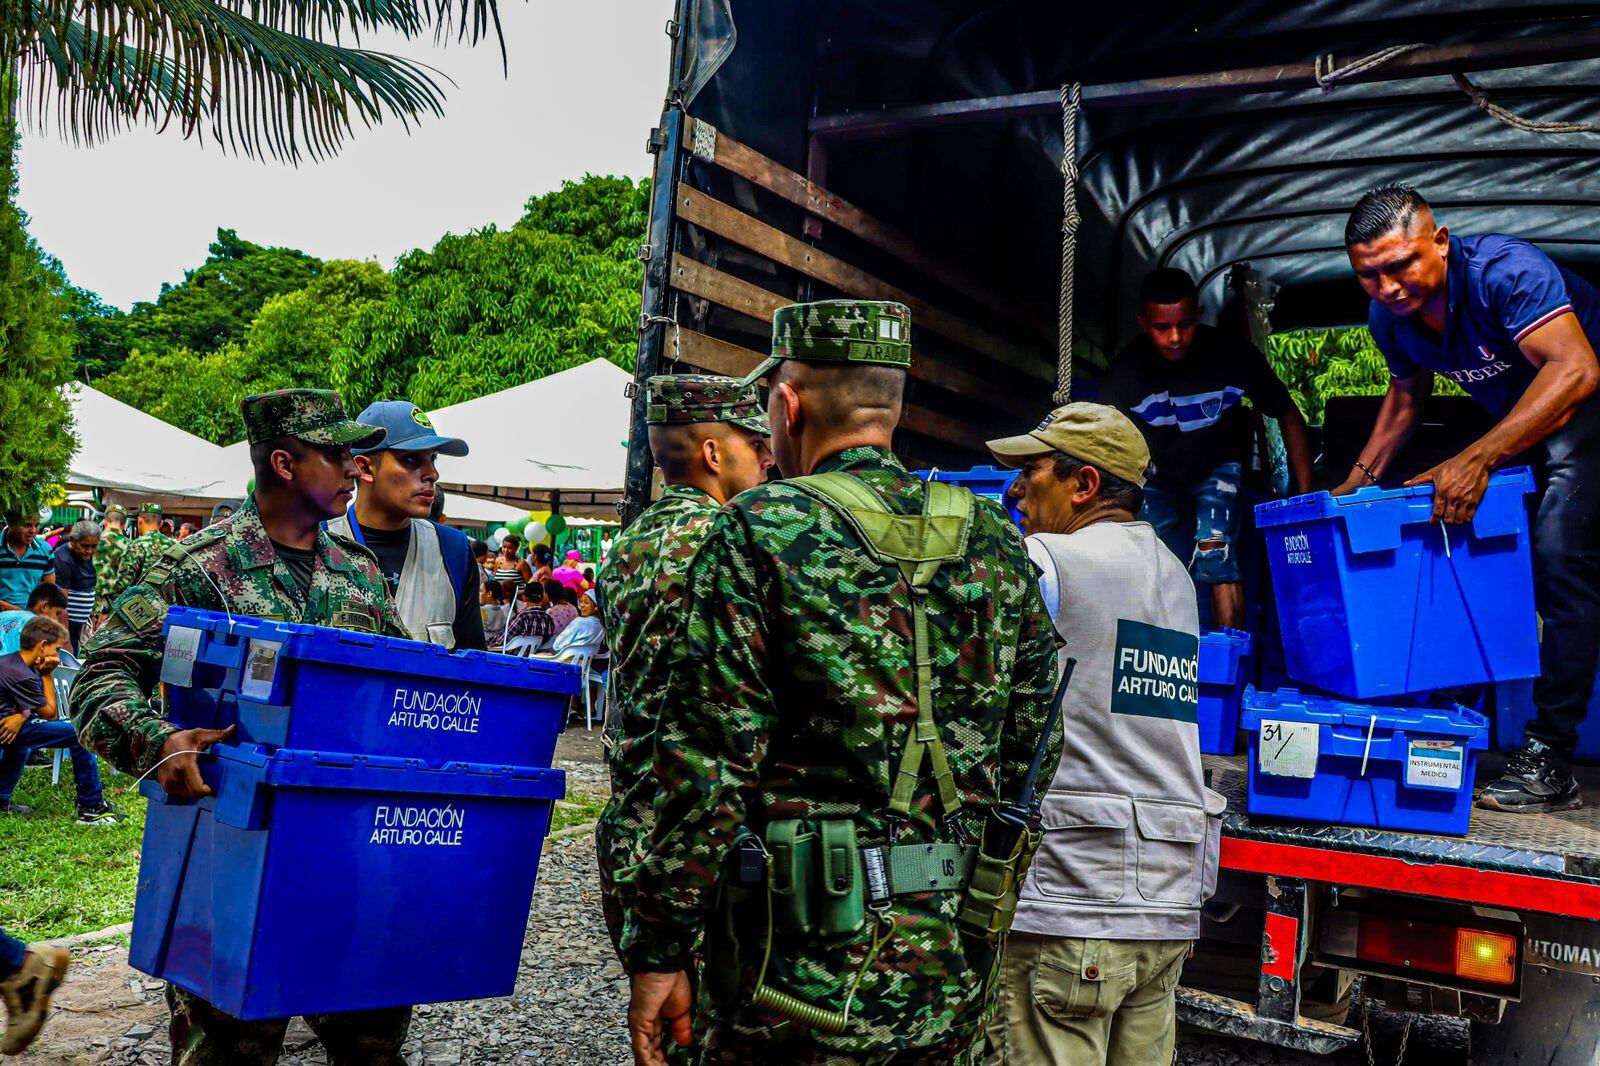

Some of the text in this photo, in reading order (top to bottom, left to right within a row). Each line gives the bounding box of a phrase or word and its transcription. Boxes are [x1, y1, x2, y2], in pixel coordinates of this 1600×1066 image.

[1118, 675, 1176, 700] ARTURO
[393, 688, 482, 716] FUNDACIÓN
[388, 711, 480, 733] ARTURO CALLE
[1410, 760, 1460, 770] INSTRUMENTAL
[374, 804, 465, 829] FUNDACIÓN
[369, 828, 463, 846] ARTURO CALLE
[941, 859, 956, 877] US
